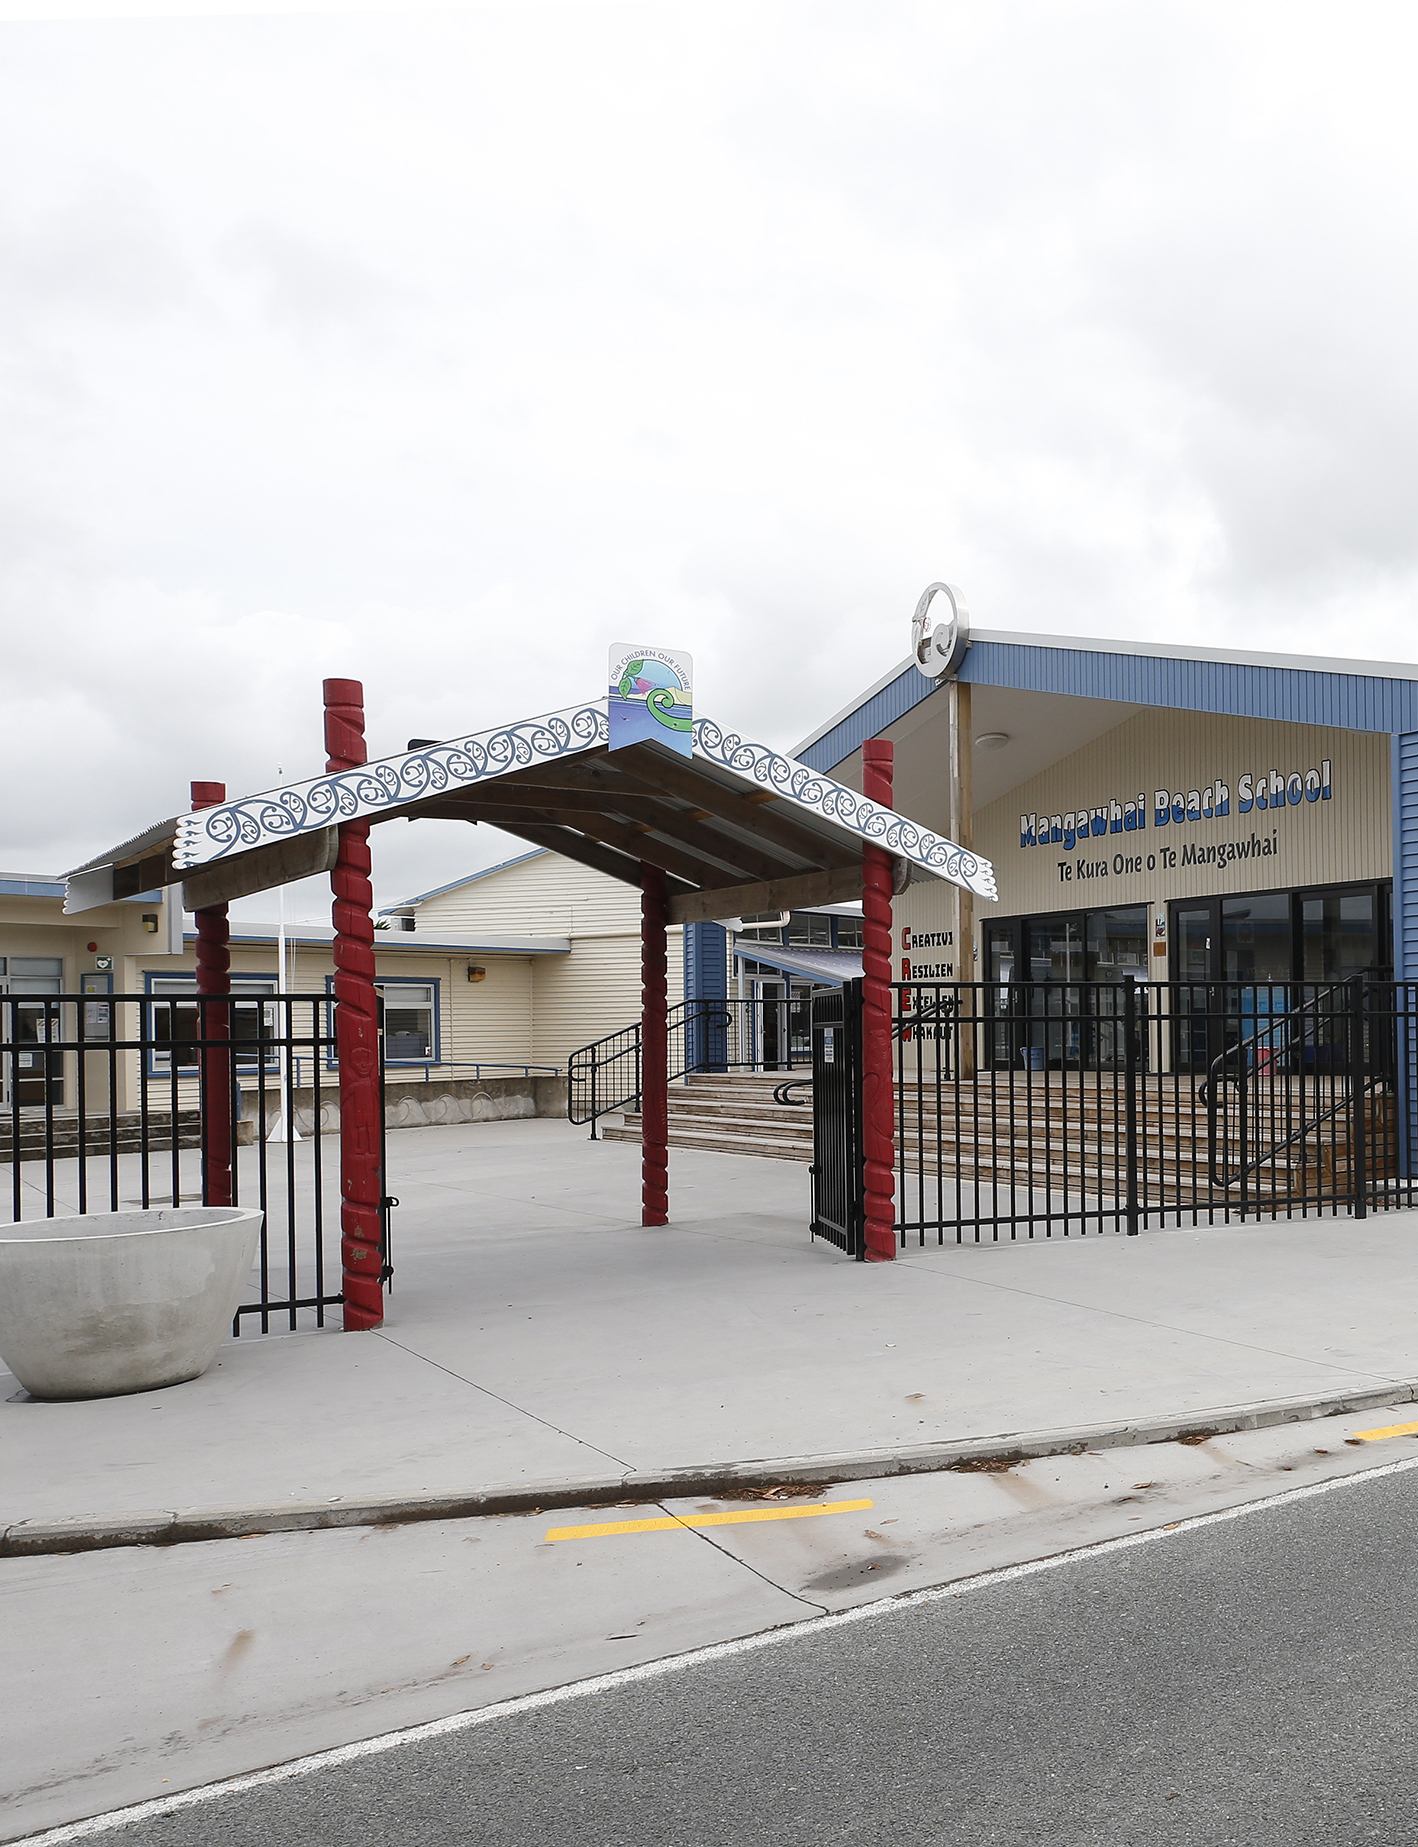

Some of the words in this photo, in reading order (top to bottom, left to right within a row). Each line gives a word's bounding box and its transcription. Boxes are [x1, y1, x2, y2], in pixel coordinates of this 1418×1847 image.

[610, 664, 622, 680] OUR
[621, 650, 656, 665] CHILDREN
[658, 653, 675, 666] OUR
[674, 665, 691, 690] FUTURE
[1020, 792, 1146, 851] Mangawhai
[1153, 779, 1230, 827] Beach
[1238, 759, 1332, 813] School
[1057, 861, 1072, 882] Te
[1076, 858, 1108, 880] Kura
[1112, 853, 1142, 875] One
[1146, 853, 1156, 871] o
[1159, 846, 1177, 869] Te
[1181, 829, 1278, 869] Mangawhai
